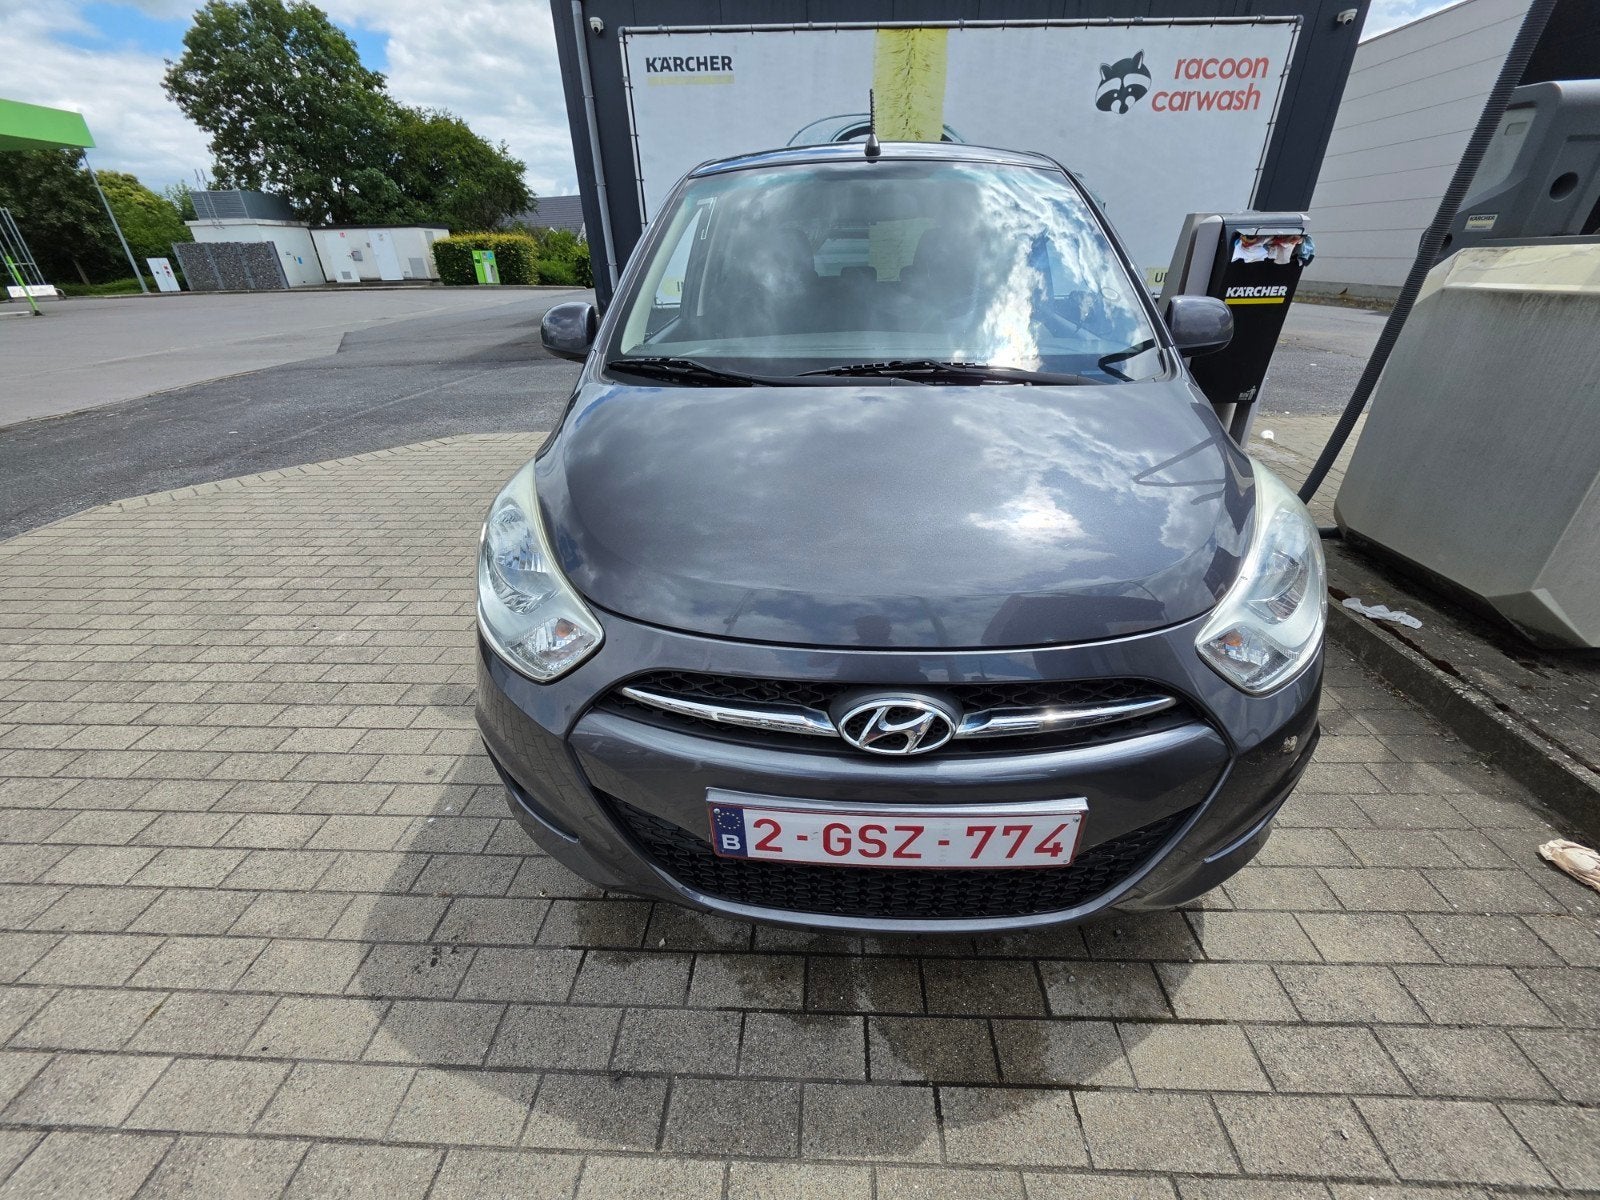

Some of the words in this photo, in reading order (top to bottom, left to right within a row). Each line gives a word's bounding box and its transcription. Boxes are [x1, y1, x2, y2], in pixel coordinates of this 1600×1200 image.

[645, 55, 733, 73] KÄRCHER
[1174, 57, 1269, 80] racoon
[1151, 82, 1261, 112] carwash
[1225, 285, 1288, 297] KÄRCHER
[721, 834, 741, 850] B
[753, 818, 1068, 859] 2-GSZ-774
